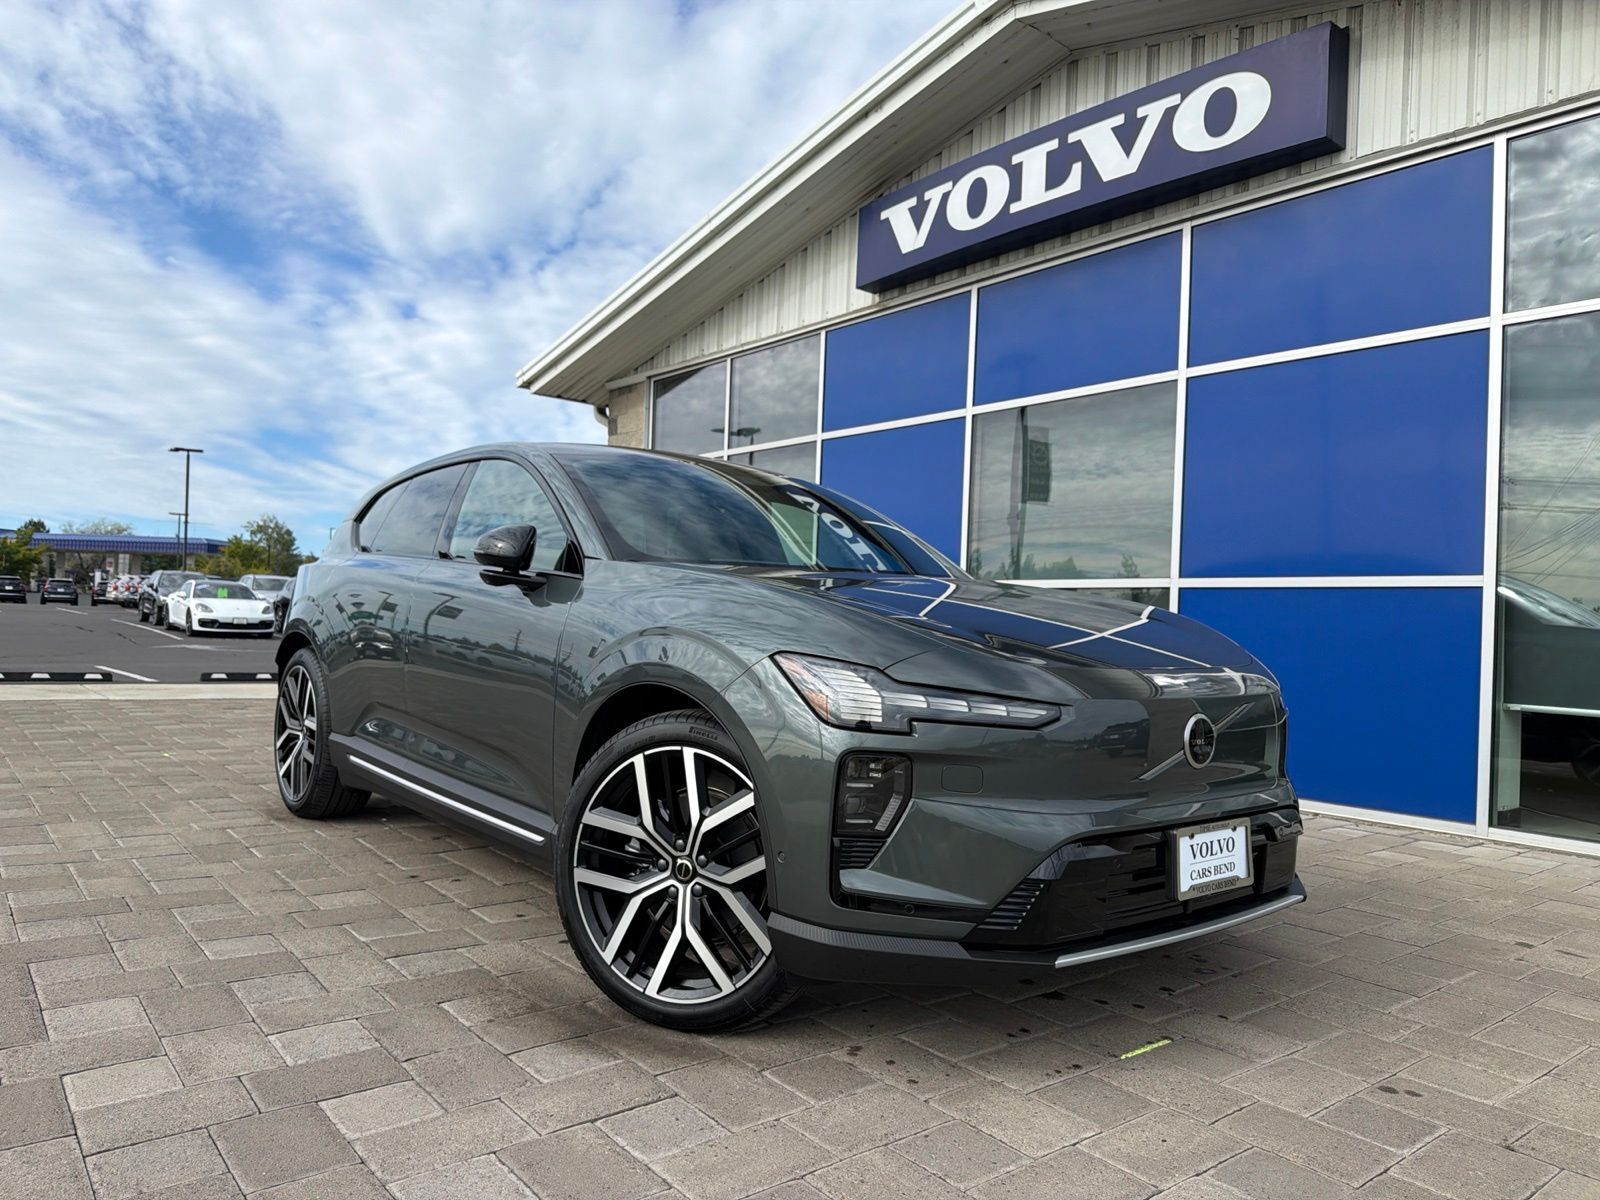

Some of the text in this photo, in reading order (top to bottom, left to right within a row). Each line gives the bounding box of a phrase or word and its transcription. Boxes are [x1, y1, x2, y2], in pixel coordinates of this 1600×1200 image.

[880, 71, 1272, 255] VOLVO
[1189, 836, 1235, 860] VOLVO
[1190, 861, 1236, 881] CARS BEND
